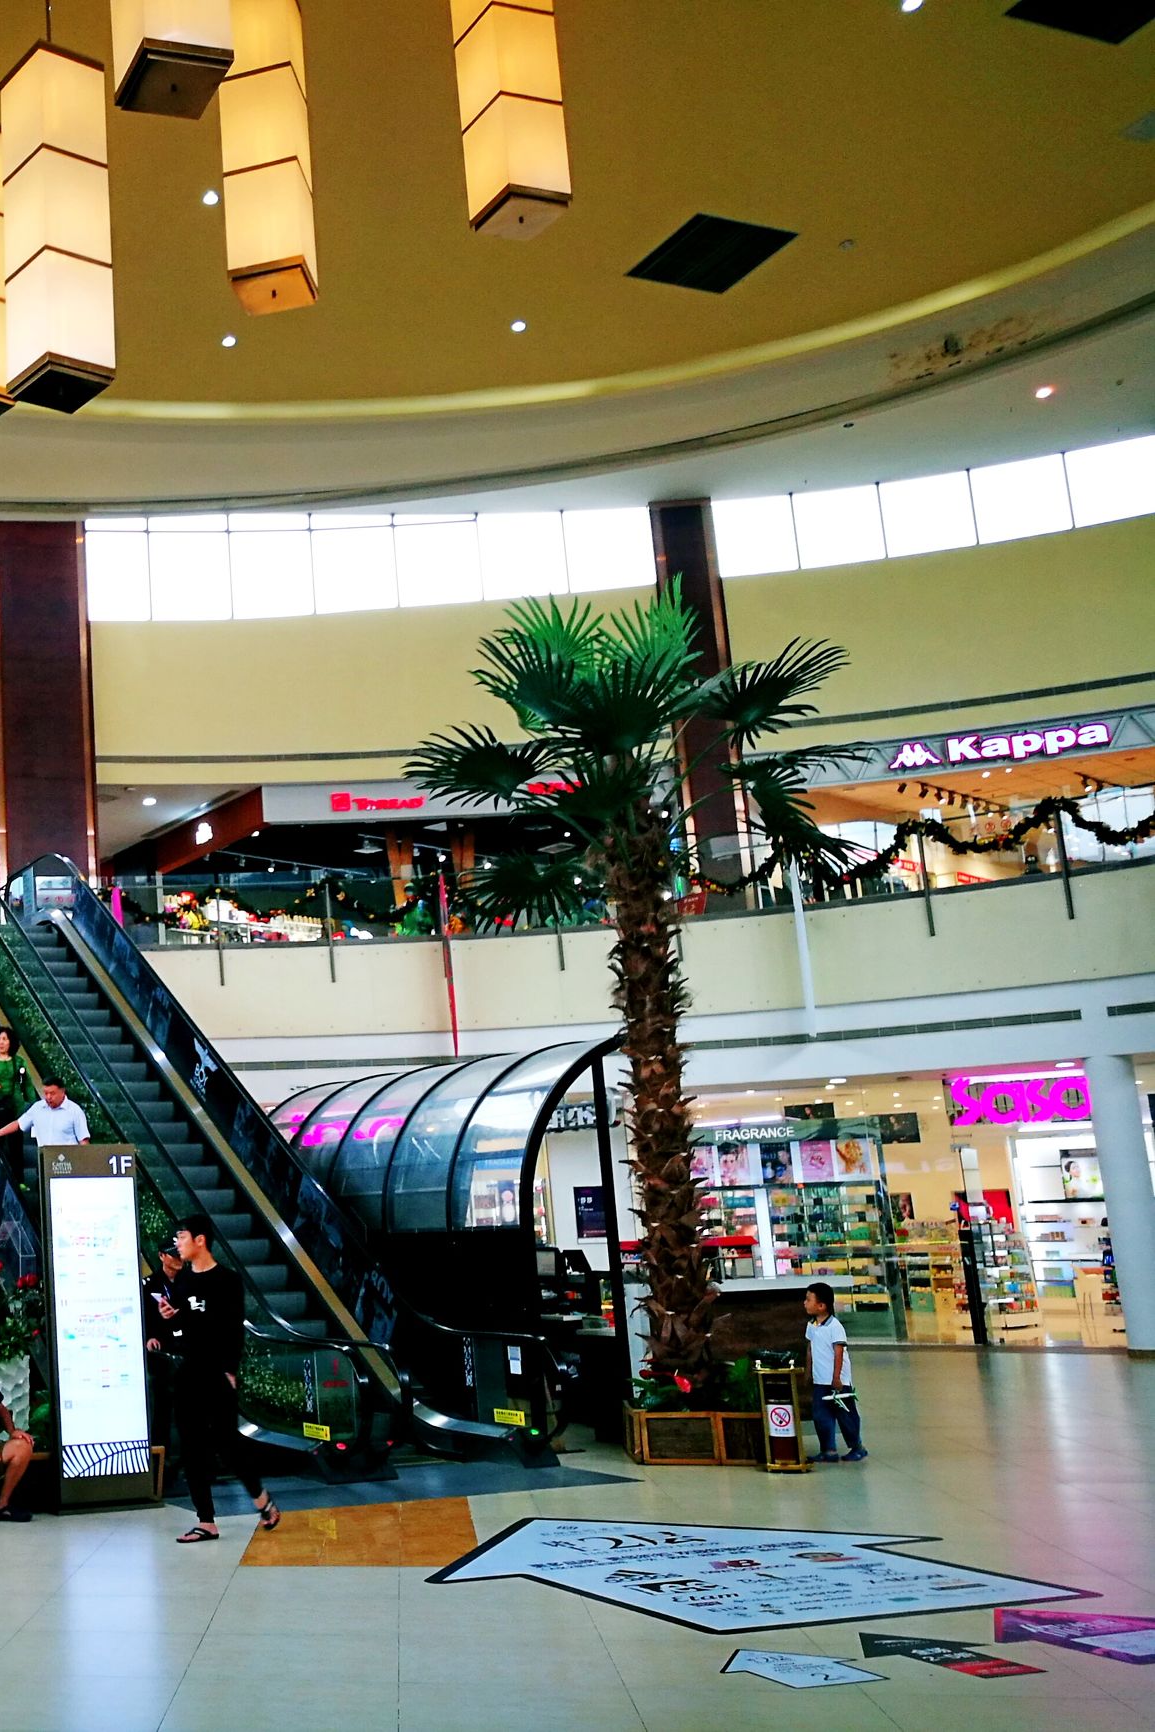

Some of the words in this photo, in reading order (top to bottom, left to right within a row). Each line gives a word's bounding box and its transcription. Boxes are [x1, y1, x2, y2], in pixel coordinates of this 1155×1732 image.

[947, 721, 1110, 762] Kappa
[714, 1126, 795, 1141] FRAGRANCE
[108, 1155, 133, 1175] 1F
